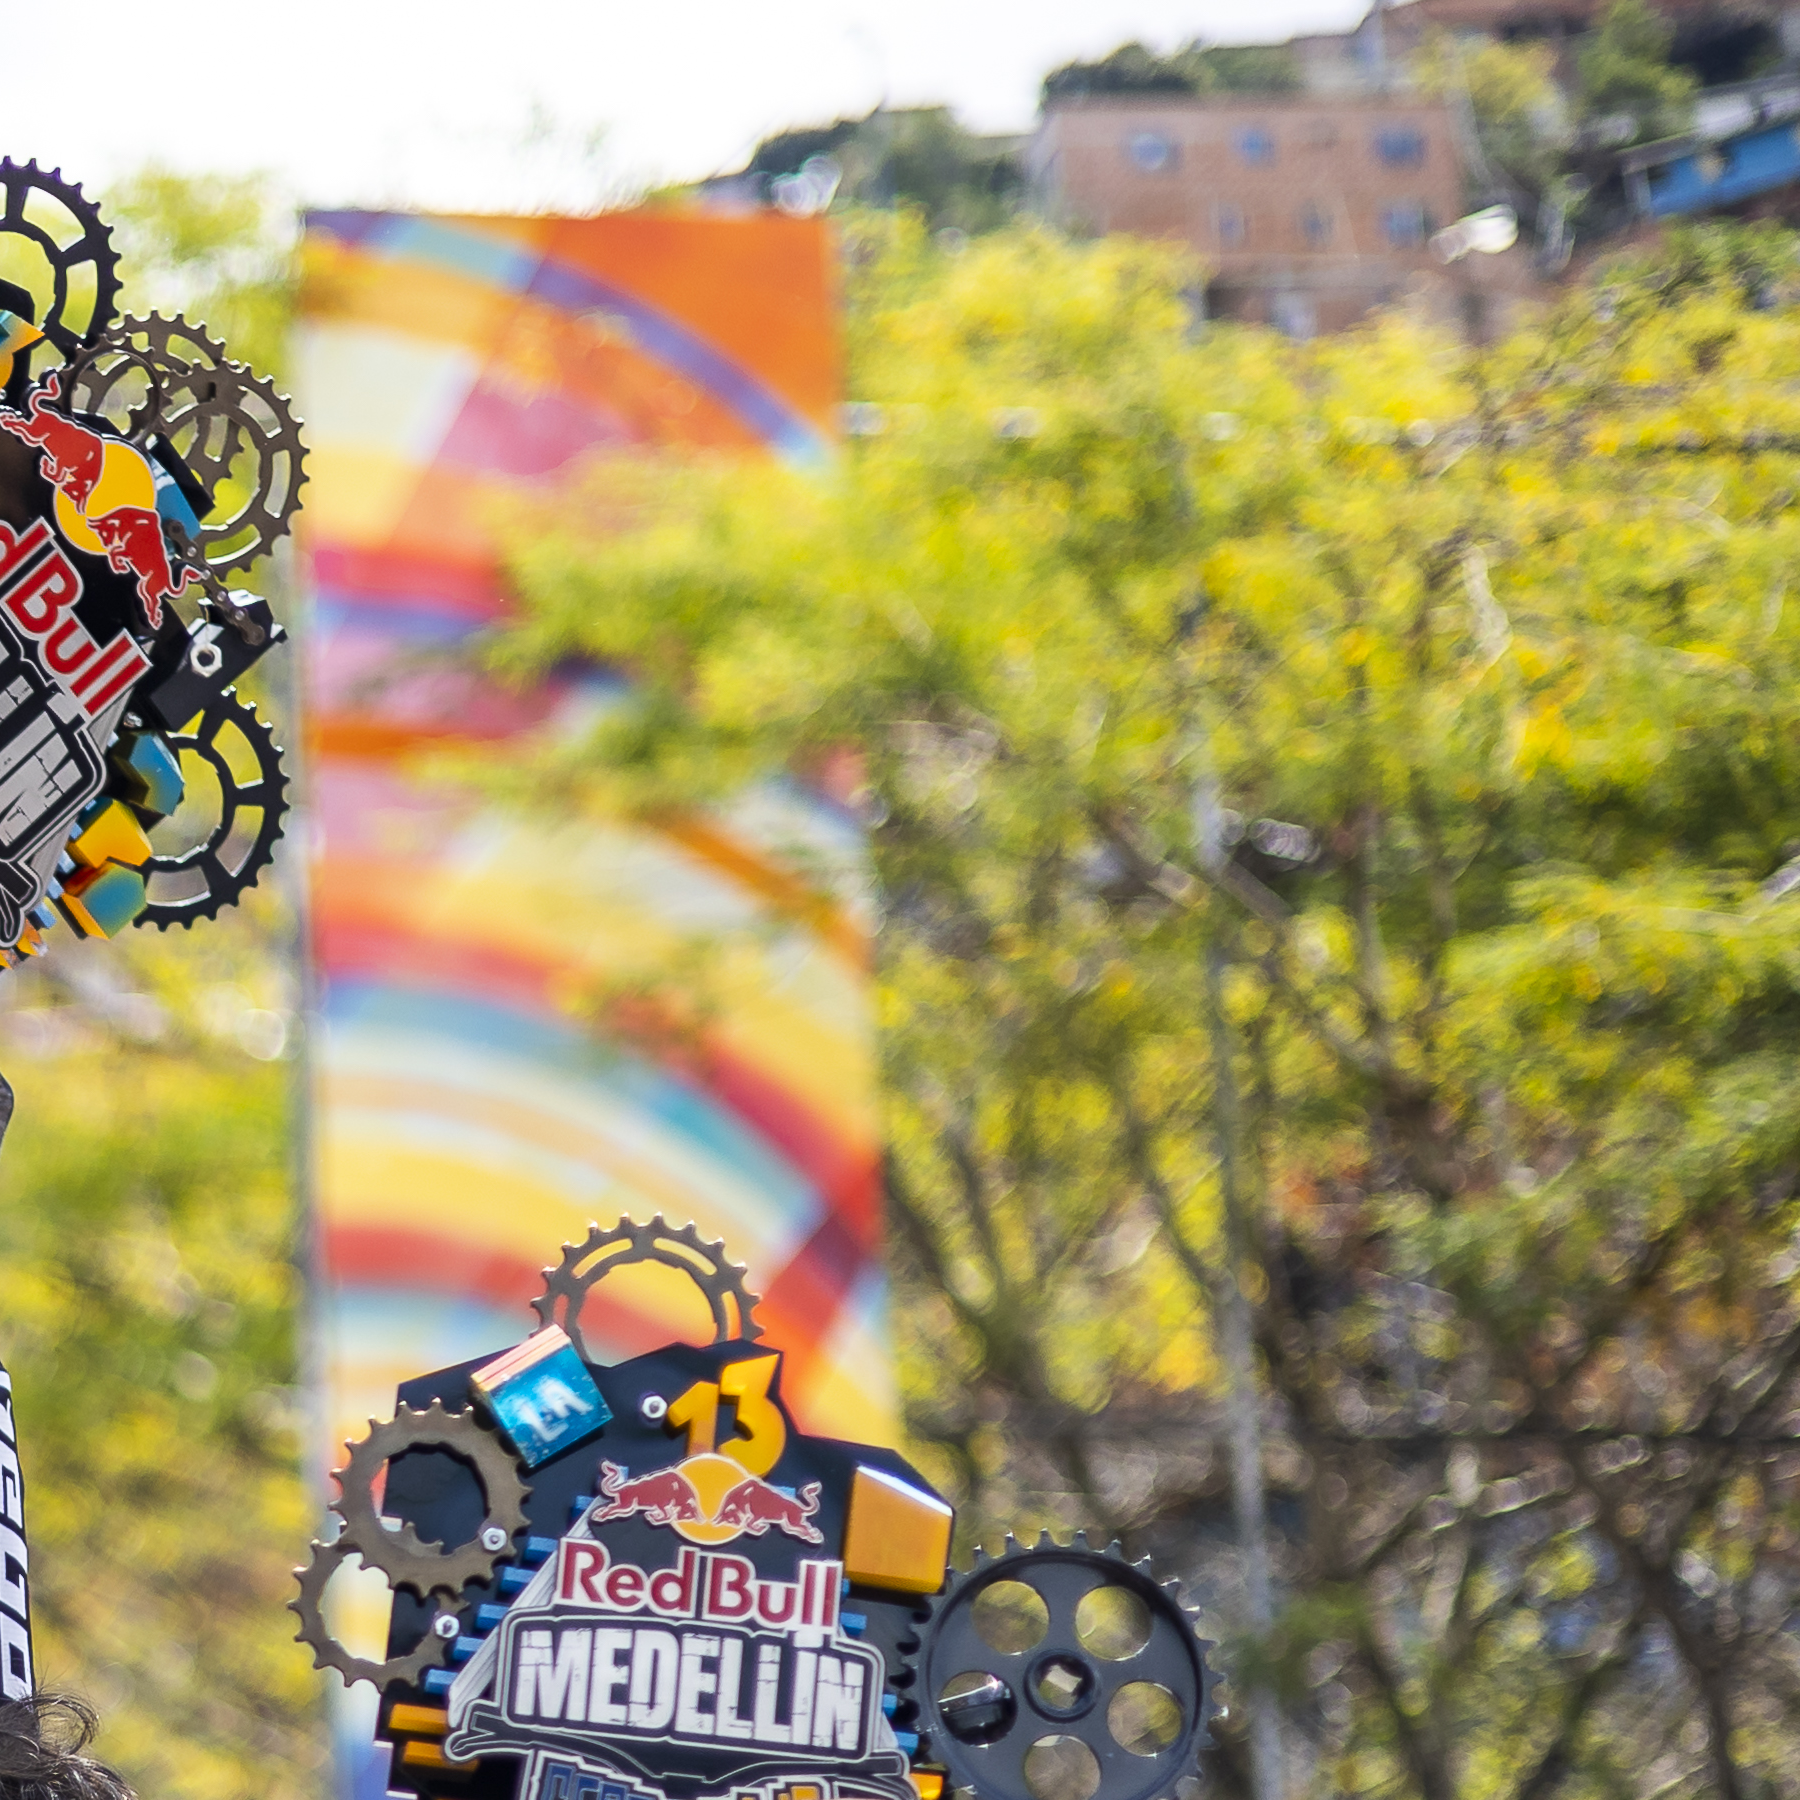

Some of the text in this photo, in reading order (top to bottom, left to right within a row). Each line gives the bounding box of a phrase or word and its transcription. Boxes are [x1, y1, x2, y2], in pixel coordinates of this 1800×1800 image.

[5, 553, 148, 716] Bull
[667, 1354, 787, 1478] 13
[561, 1542, 838, 1626] Red Bull
